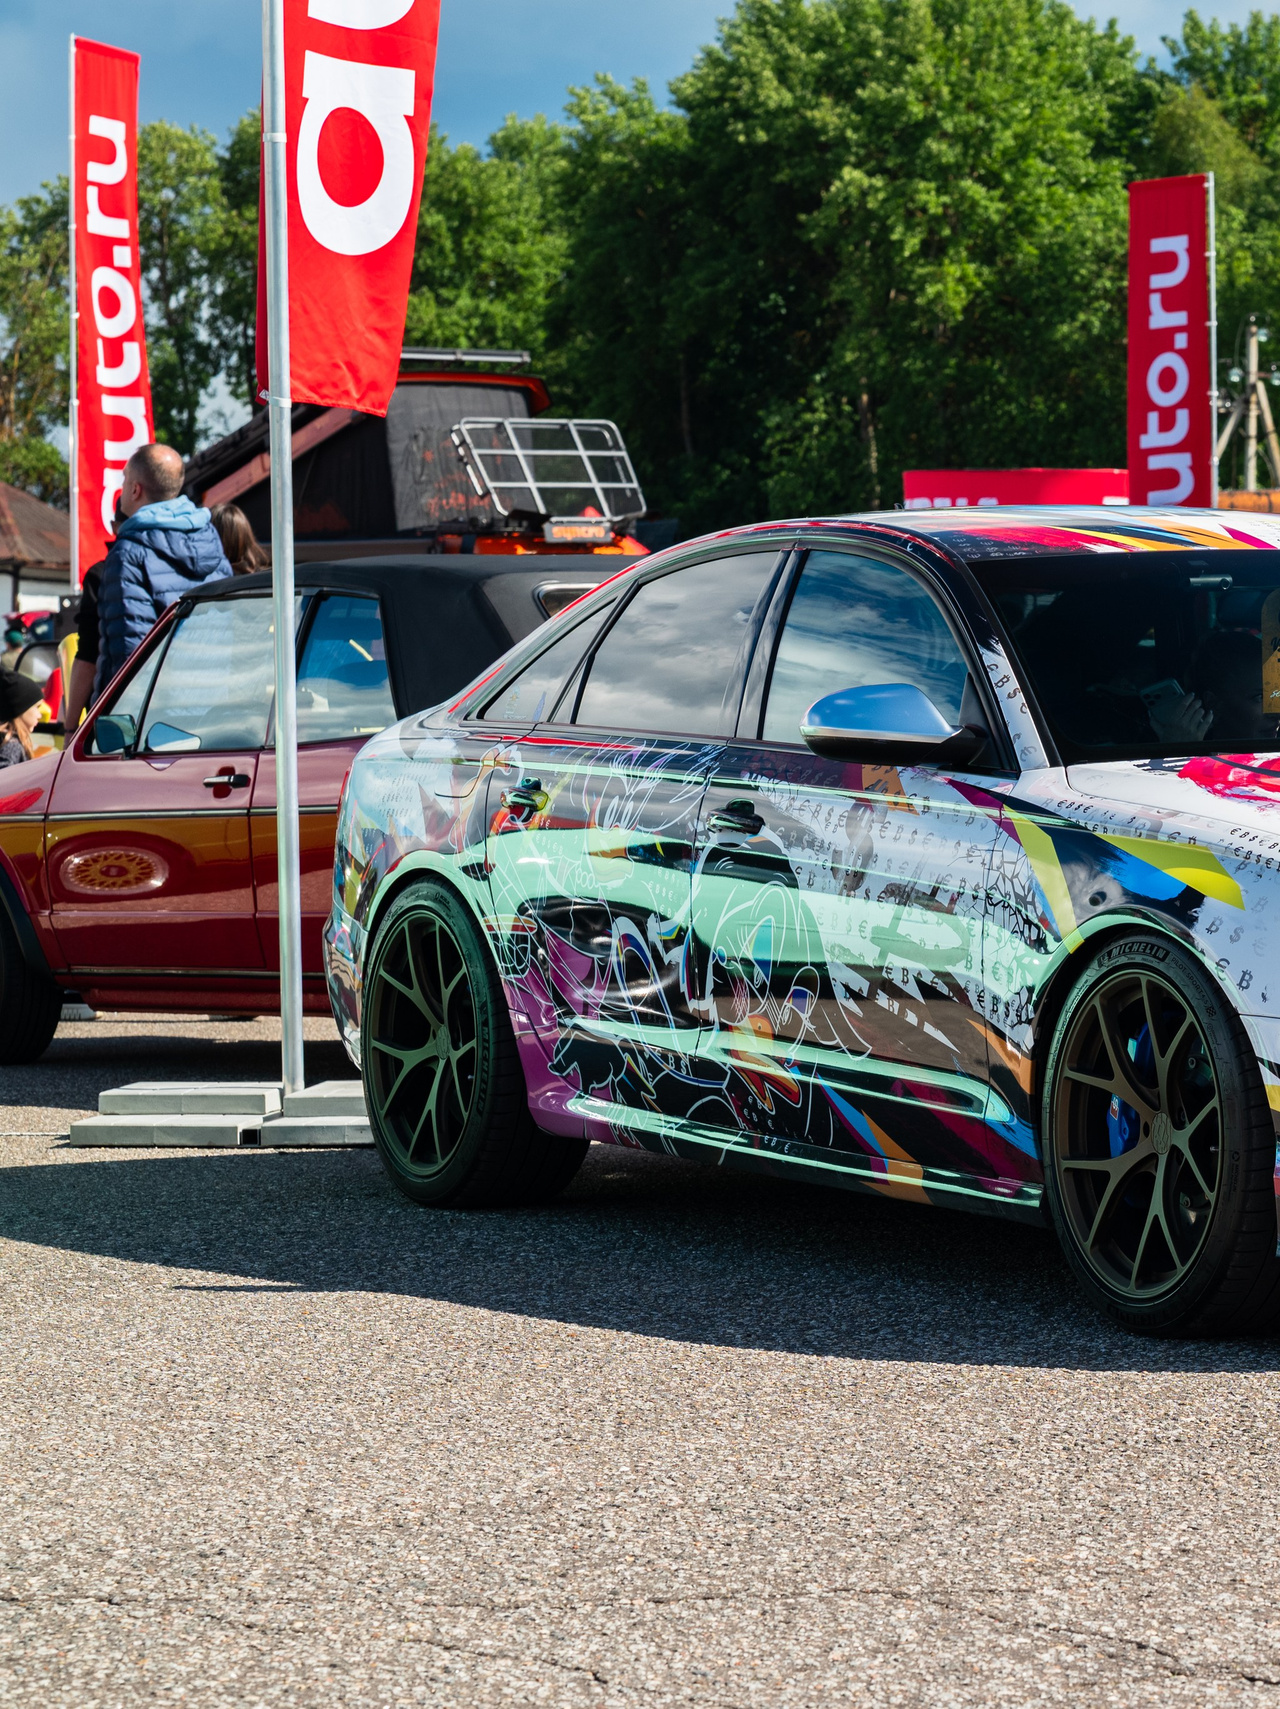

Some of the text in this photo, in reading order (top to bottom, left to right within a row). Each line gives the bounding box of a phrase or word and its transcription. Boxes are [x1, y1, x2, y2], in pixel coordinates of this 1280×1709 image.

[296, 0, 417, 256] a
[1110, 942, 1167, 959] MICHELIN
[1171, 957, 1188, 974] PILOT
[1186, 971, 1204, 994] SPORT
[478, 1026, 489, 1112] MICHELIN
